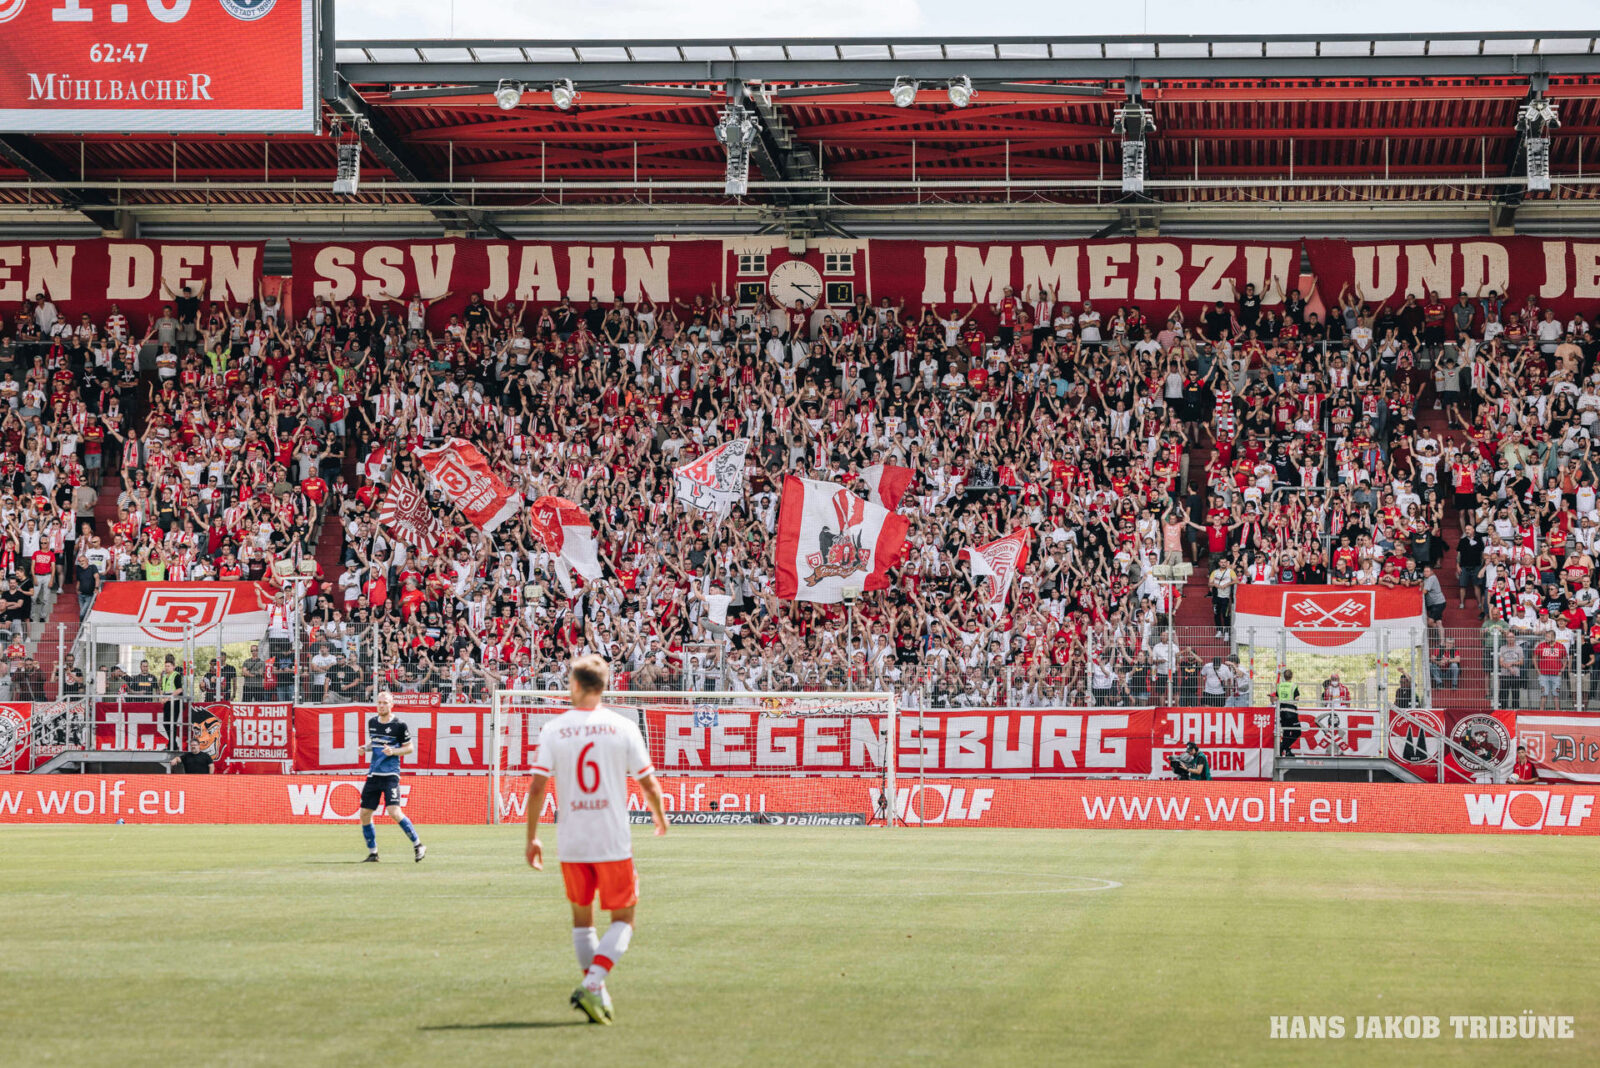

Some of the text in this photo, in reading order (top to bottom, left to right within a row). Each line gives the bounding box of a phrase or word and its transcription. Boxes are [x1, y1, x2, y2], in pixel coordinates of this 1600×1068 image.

[89, 43, 149, 63] 62:47
[107, 243, 258, 300] DEN
[313, 245, 671, 303] SSV JAHN
[922, 245, 1293, 303] IMMERZU
[1353, 244, 1509, 300] UND
[233, 706, 288, 717] SSV JAHN
[1163, 712, 1245, 745] JAHN
[232, 718, 288, 747] 1889
[663, 713, 1129, 768] REGENSBURG
[233, 748, 288, 758] REGENSBURG
[576, 741, 601, 794] 6
[391, 787, 398, 798] 3
[1081, 788, 1358, 823] www.wolf.eu
[1464, 790, 1595, 830] WOLF
[786, 815, 859, 826] Dallmeier
